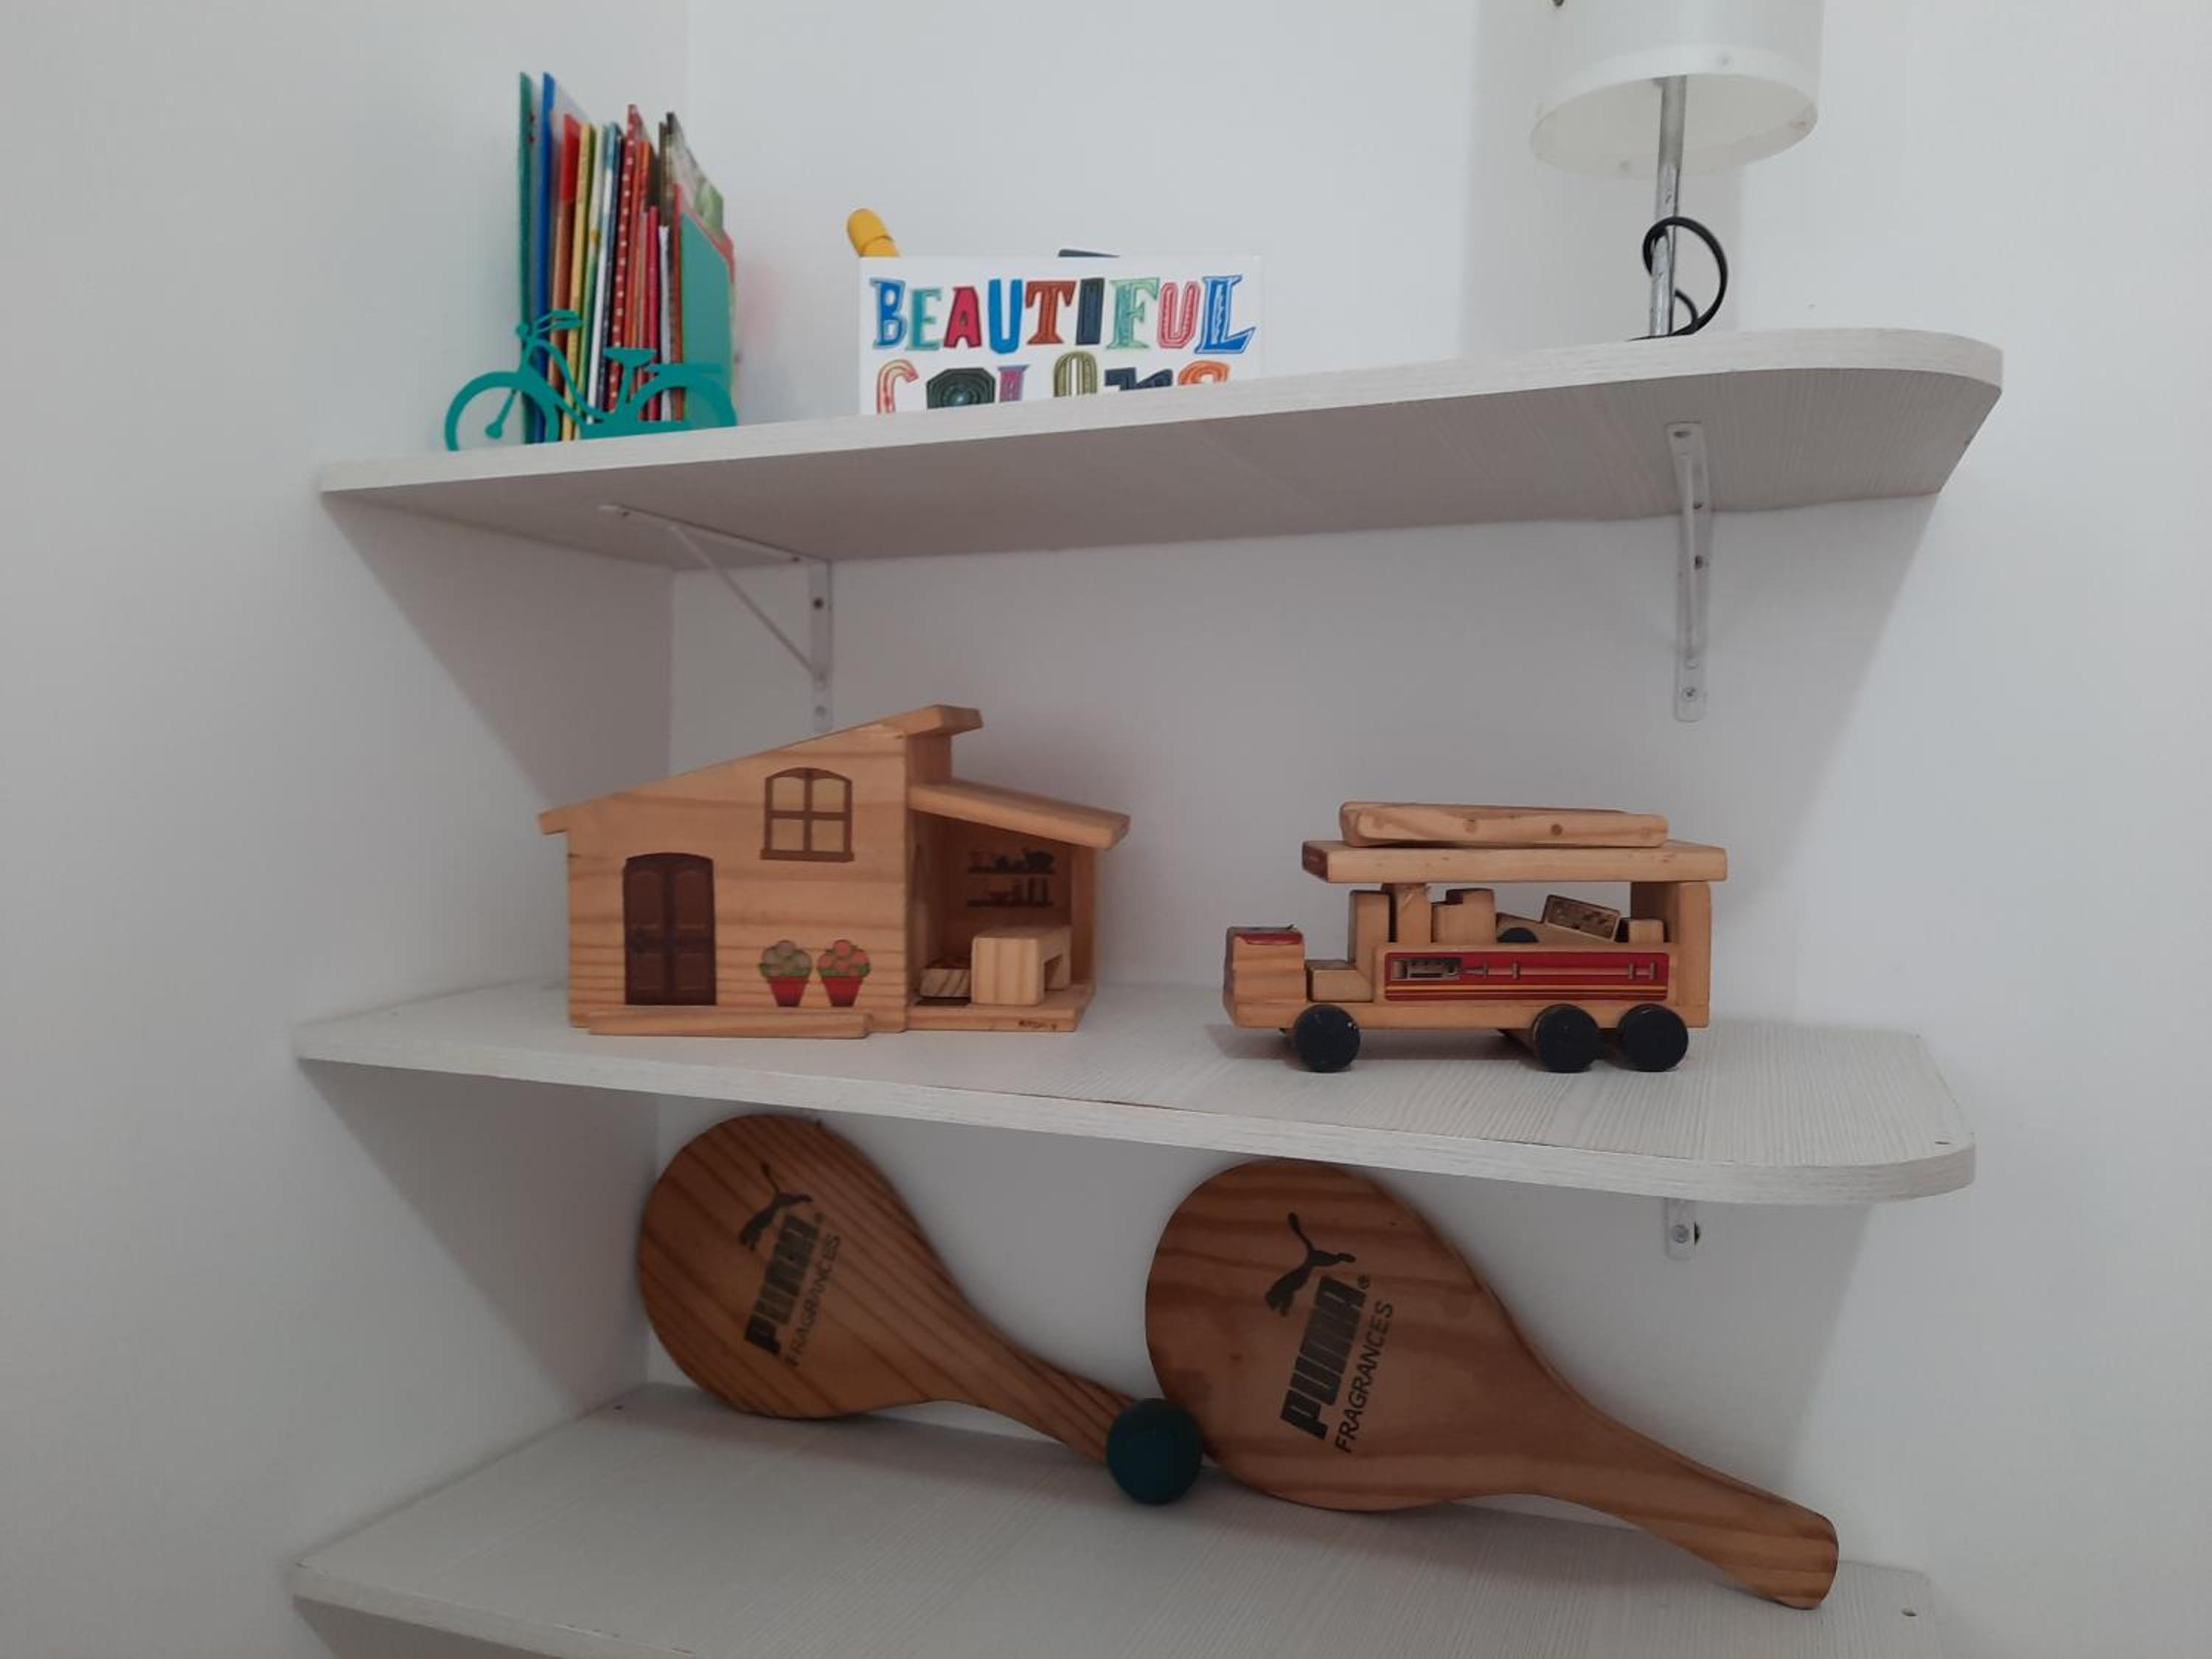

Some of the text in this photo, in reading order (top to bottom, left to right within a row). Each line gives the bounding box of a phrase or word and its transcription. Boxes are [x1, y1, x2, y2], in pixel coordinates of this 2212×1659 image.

[870, 275, 1256, 353] BEAUTIFUL
[744, 1214, 820, 1356] PUMA
[784, 1234, 841, 1368] FRAGRANCES
[1281, 1276, 1368, 1439] PUMA
[1335, 1301, 1393, 1453] FRAGRANCES
